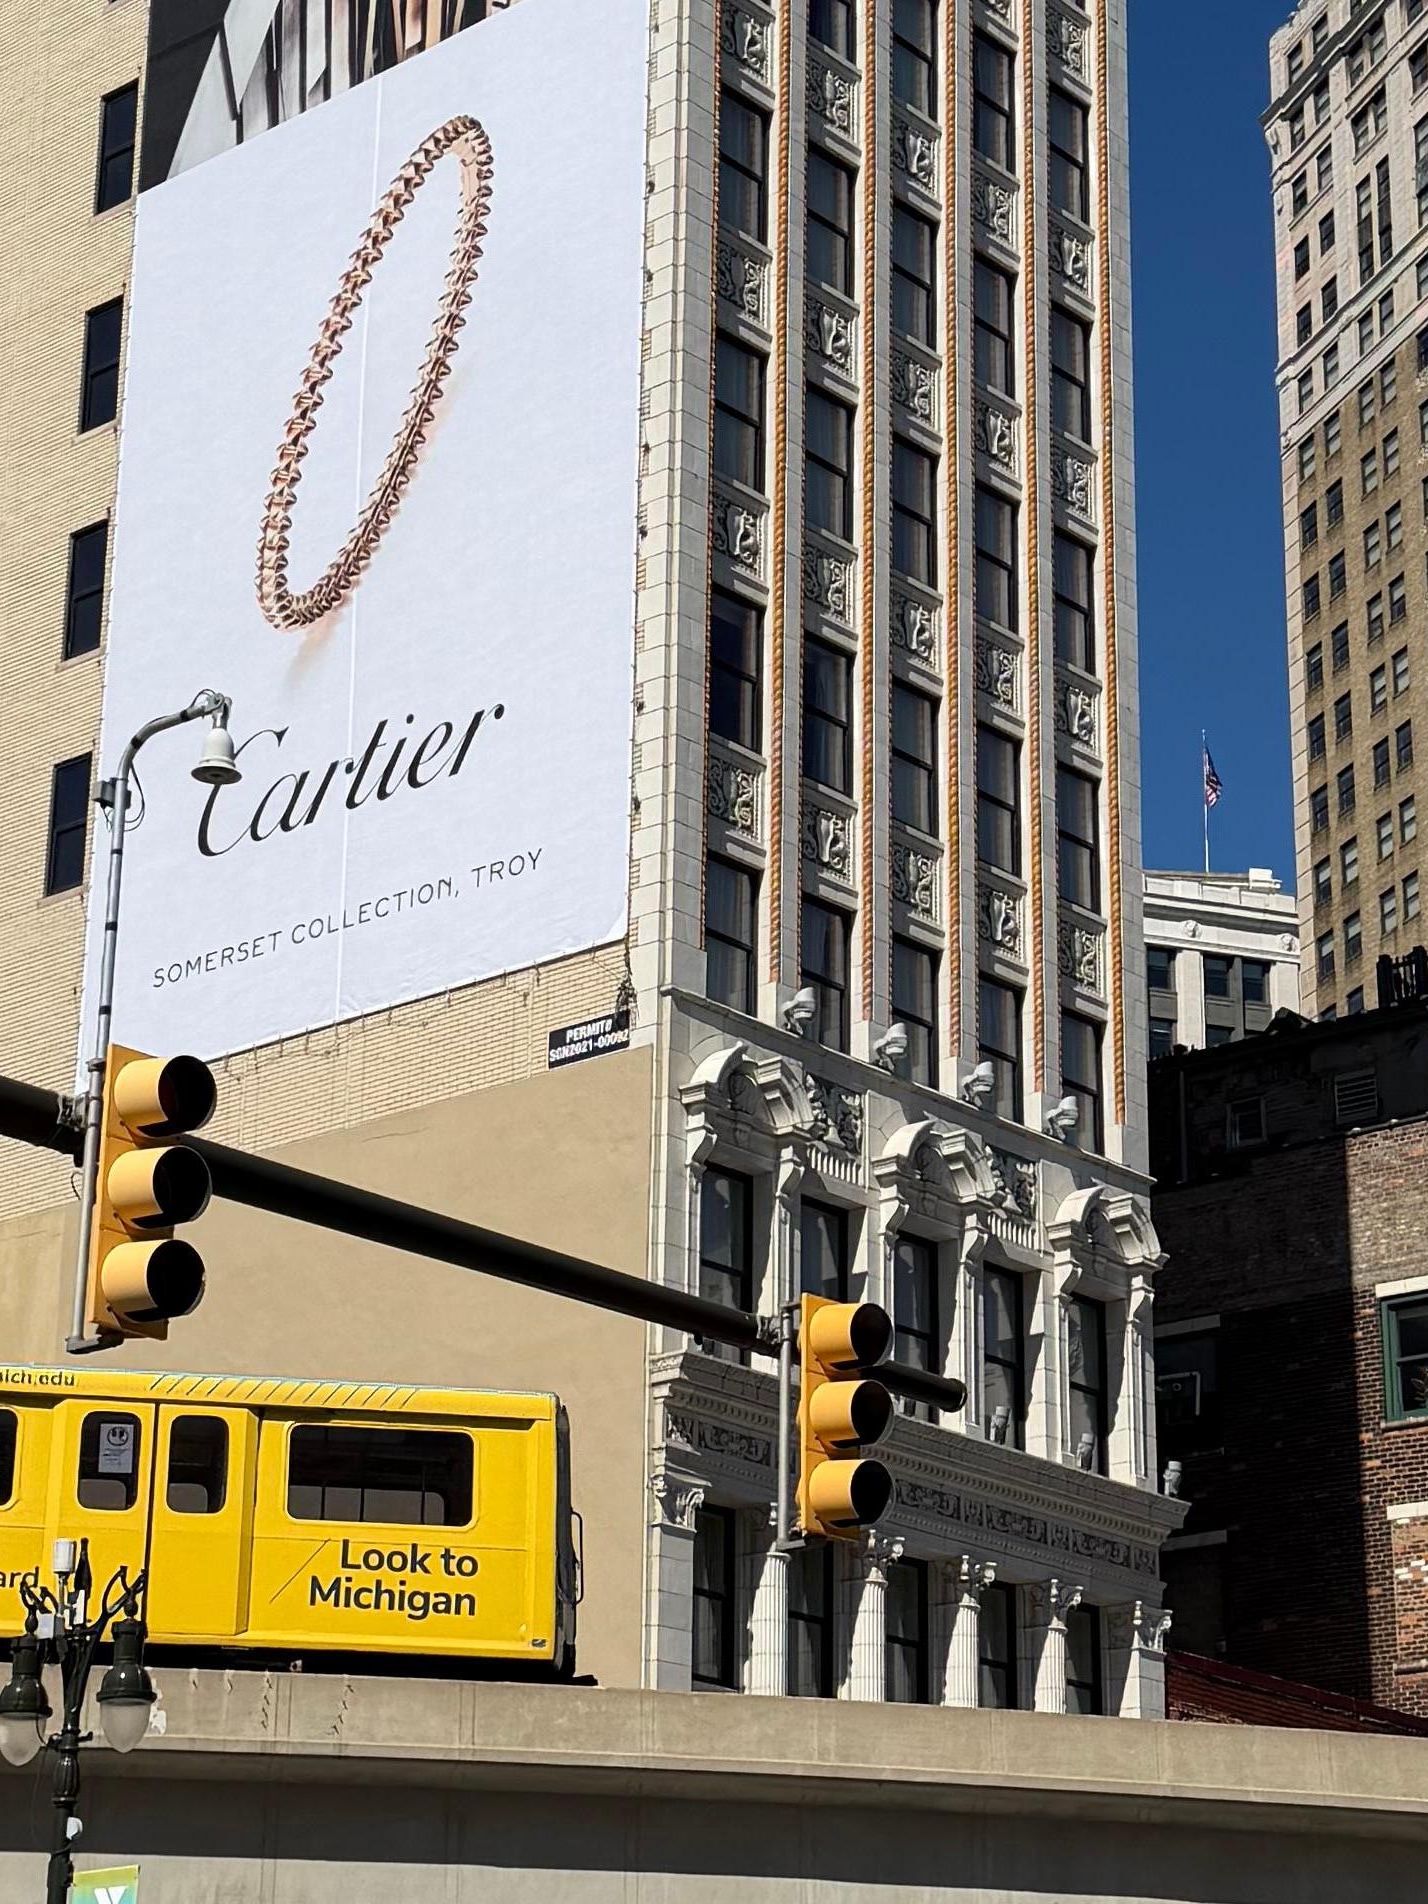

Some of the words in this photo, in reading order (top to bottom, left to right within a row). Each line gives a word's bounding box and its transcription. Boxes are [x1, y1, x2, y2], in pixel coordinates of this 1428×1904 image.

[197, 702, 505, 857] Cartier
[152, 930, 282, 988] SOMERSET
[290, 877, 461, 946] COLLECTION,
[471, 847, 543, 890] TROY
[309, 1575, 476, 1620] Michigan
[341, 1539, 432, 1574] Look
[440, 1547, 479, 1577] to
